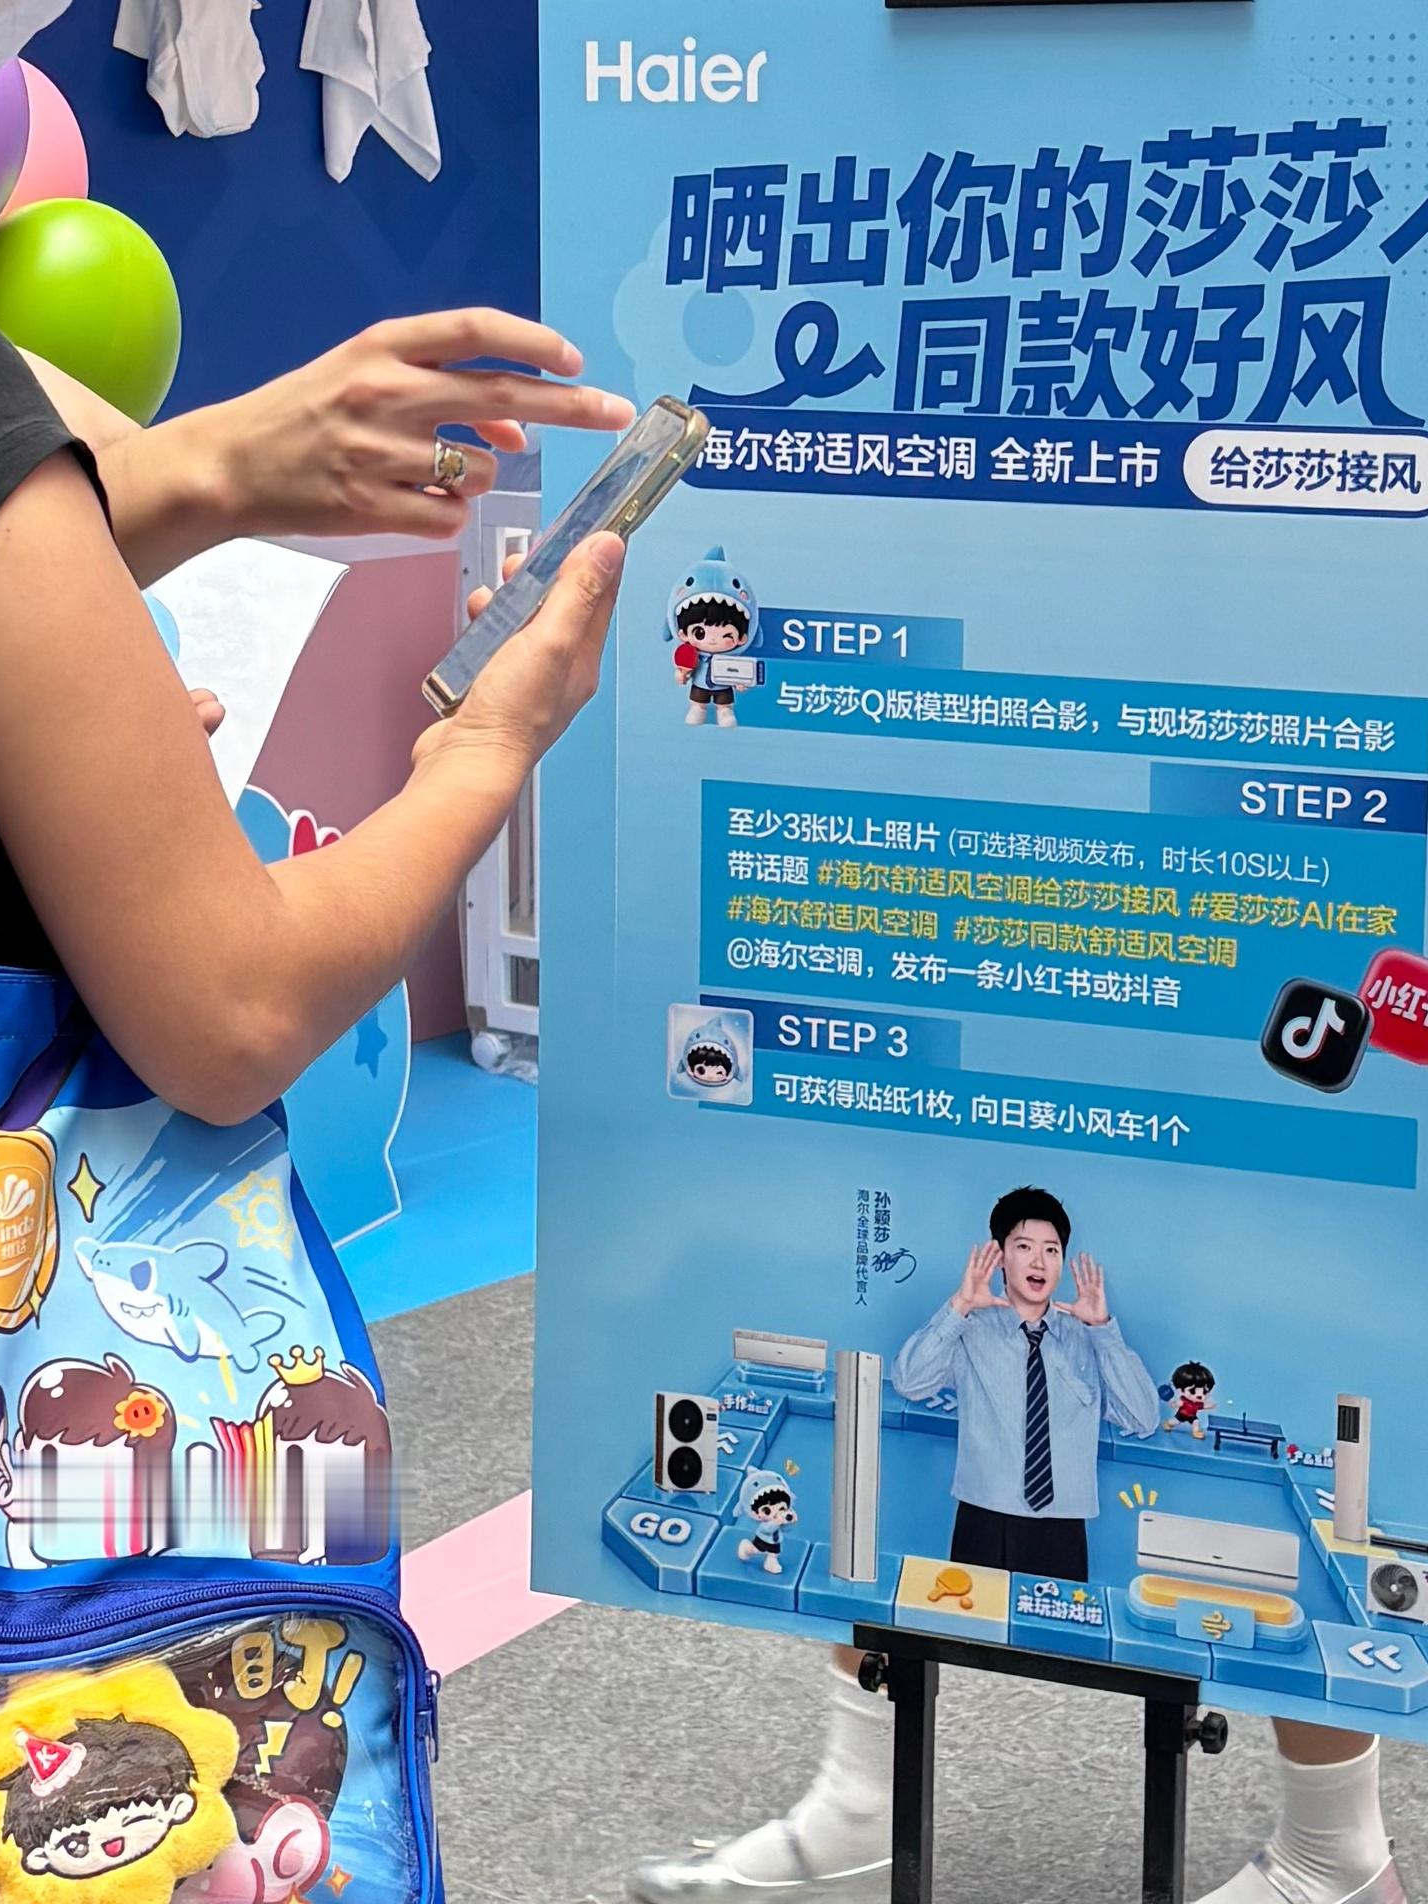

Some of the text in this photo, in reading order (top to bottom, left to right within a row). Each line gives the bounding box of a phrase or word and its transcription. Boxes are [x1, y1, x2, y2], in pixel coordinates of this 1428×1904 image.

[584, 36, 768, 103] Haier
[665, 117, 1386, 294] 晒出你的莎莎
[894, 276, 1425, 428] 同款好风
[695, 426, 1421, 495] 海尔舒适风空调 全新上市 给莎莎接风
[782, 619, 908, 658] STEP 1
[776, 681, 1395, 752] 与莎莎Q版模型拍照合影，与现场莎莎照片合影
[728, 807, 941, 853] 至少3张以上照片
[1240, 780, 1388, 824] STEP 2
[727, 850, 1398, 936] 带话题 #海尔舒适风空调给莎莎接风 #爱莎莎AI在家
[727, 894, 1237, 968] #海尔舒适风空调 #莎莎同款舒适风空调
[727, 937, 1182, 1008] @海尔空调，发布一条小红书或抖音
[778, 1014, 909, 1058] STEP 3
[856, 1188, 870, 1306] 海尔全球品牌代言人
[874, 1191, 891, 1243] 孙颖莎
[630, 1512, 692, 1544] GO
[1016, 1595, 1104, 1625] 来玩游戏啦
